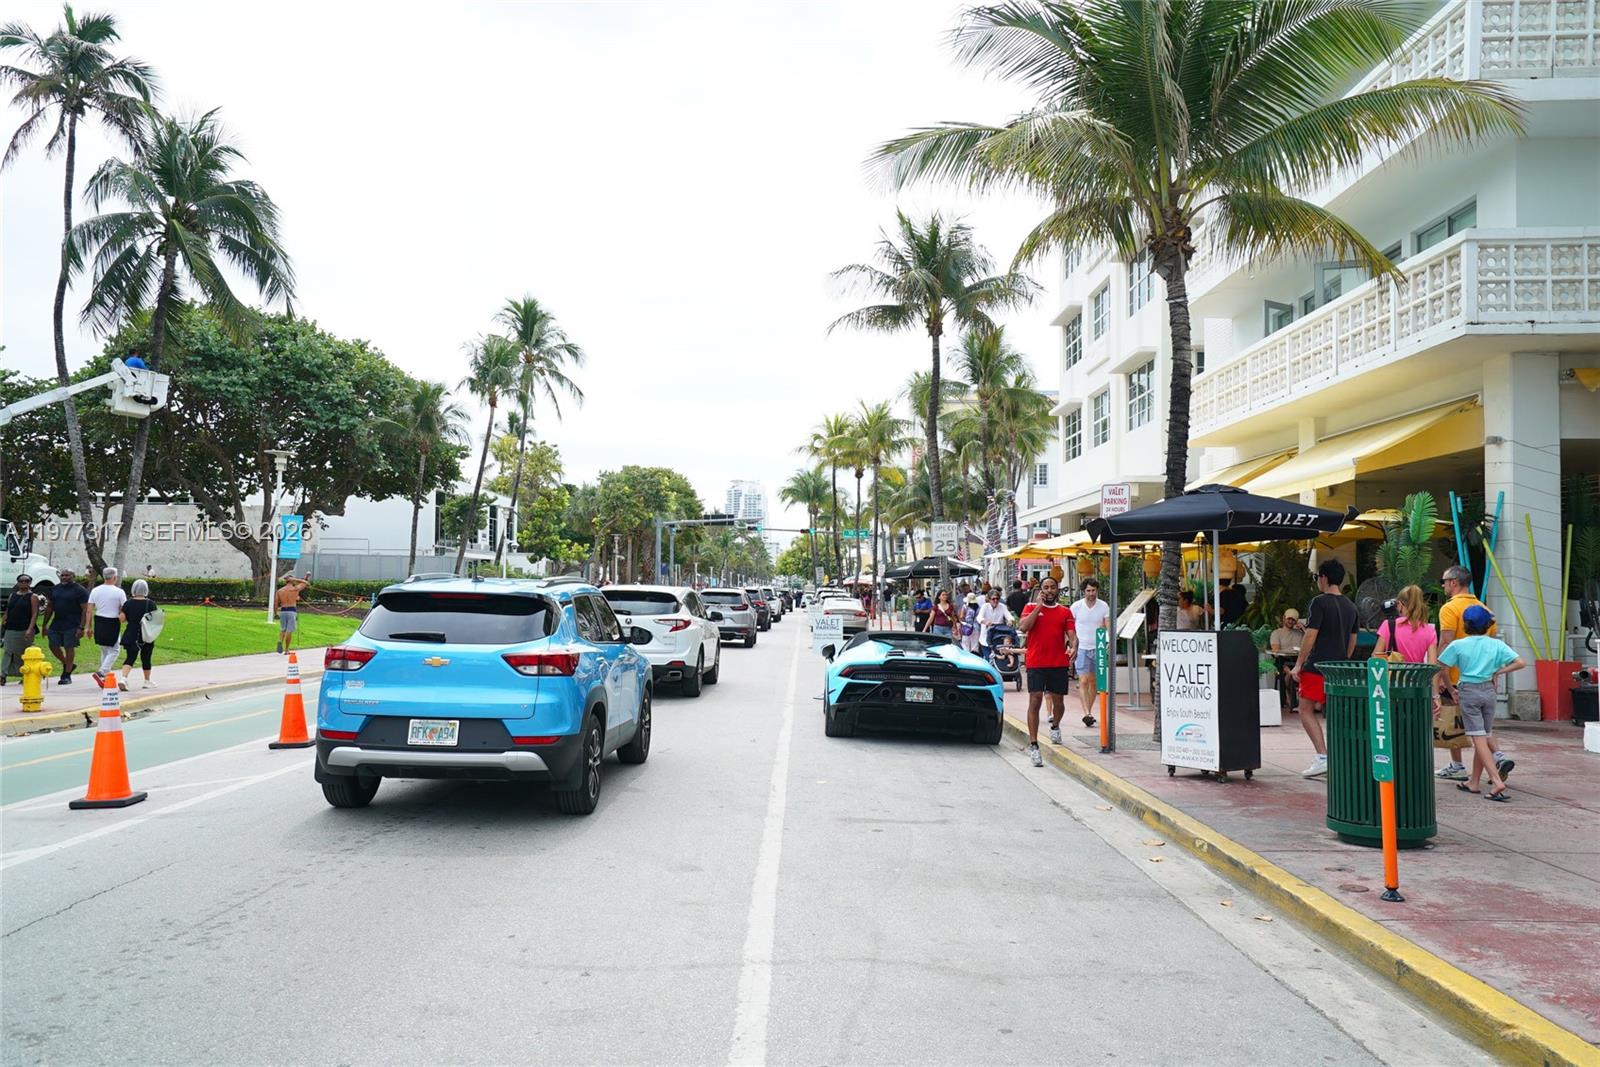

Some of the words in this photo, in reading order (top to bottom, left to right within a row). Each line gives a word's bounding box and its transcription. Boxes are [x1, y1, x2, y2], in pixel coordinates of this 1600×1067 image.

[1108, 487, 1124, 496] VALET
[1259, 512, 1319, 526] VALET
[934, 540, 956, 552] 25
[815, 618, 840, 626] VALET
[1161, 638, 1213, 653] WELCOME
[1097, 632, 1105, 675] VALET
[1164, 663, 1212, 685] VALET
[1169, 684, 1212, 701] PARKING
[1371, 667, 1386, 750] VALET
